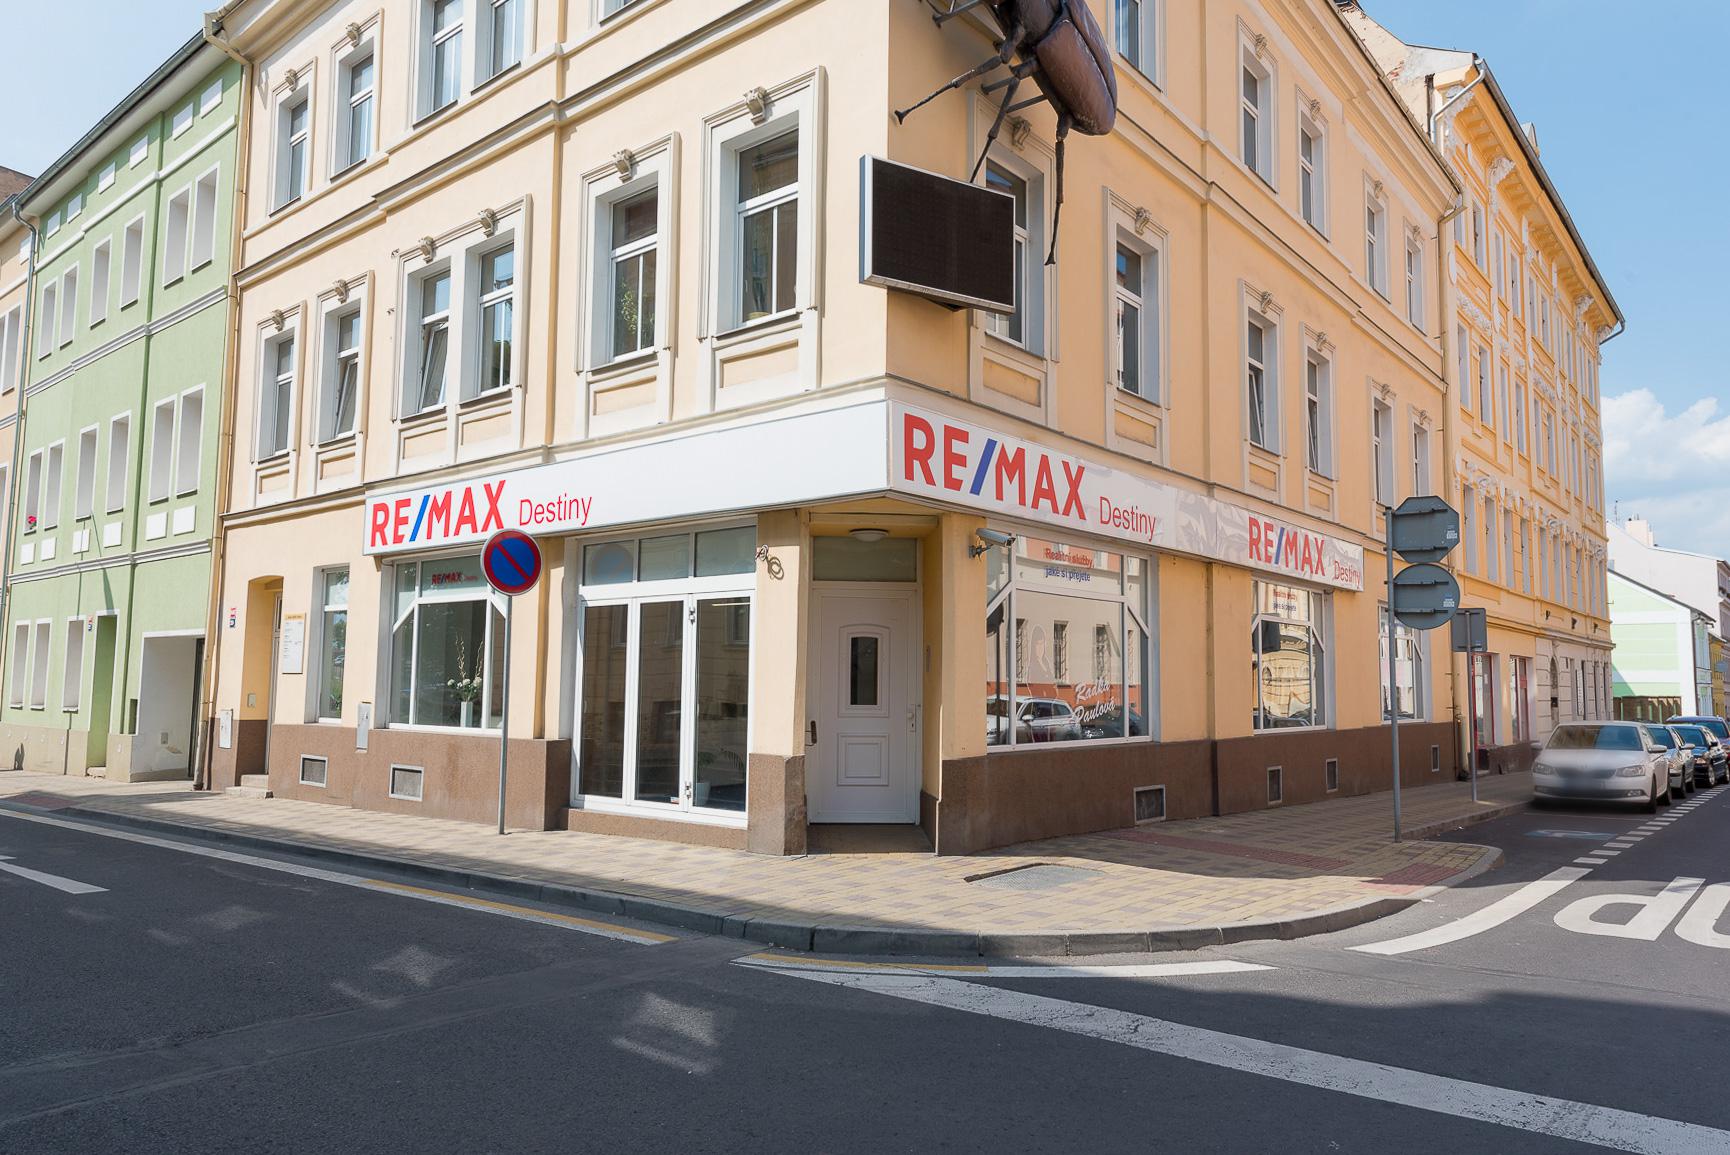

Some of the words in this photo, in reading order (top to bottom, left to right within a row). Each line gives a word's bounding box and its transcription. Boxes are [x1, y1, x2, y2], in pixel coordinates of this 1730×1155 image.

[370, 480, 506, 547] RE/MAX
[519, 493, 592, 526] Destiny
[904, 413, 1086, 520] RE/MAX
[1099, 496, 1156, 542] Destiny
[1248, 516, 1325, 576] RE/MAX
[1334, 560, 1361, 589] Destiny
